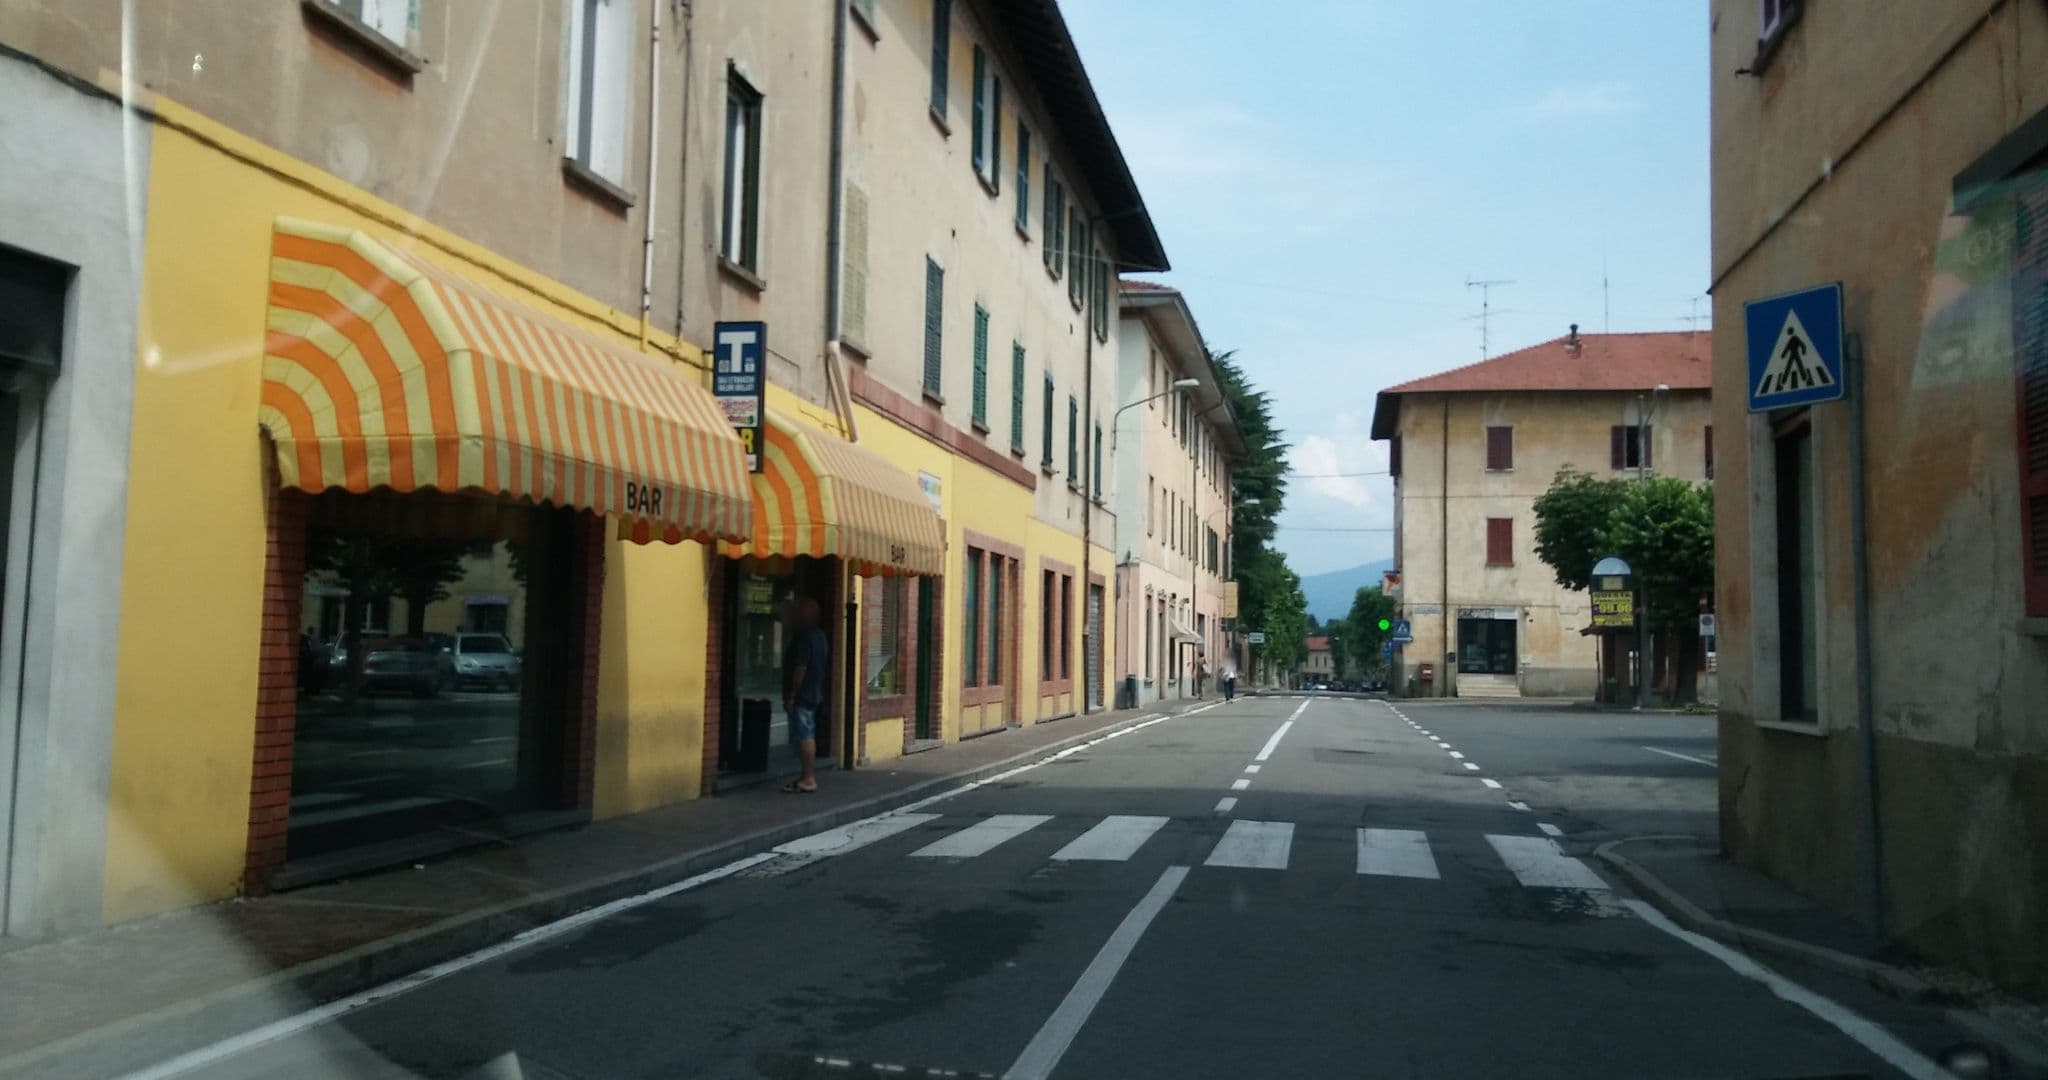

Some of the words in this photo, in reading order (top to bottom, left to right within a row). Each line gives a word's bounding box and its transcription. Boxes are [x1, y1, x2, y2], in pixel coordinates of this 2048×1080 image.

[718, 330, 757, 373] T
[626, 481, 662, 516] BAR
[890, 544, 906, 566] BAR
